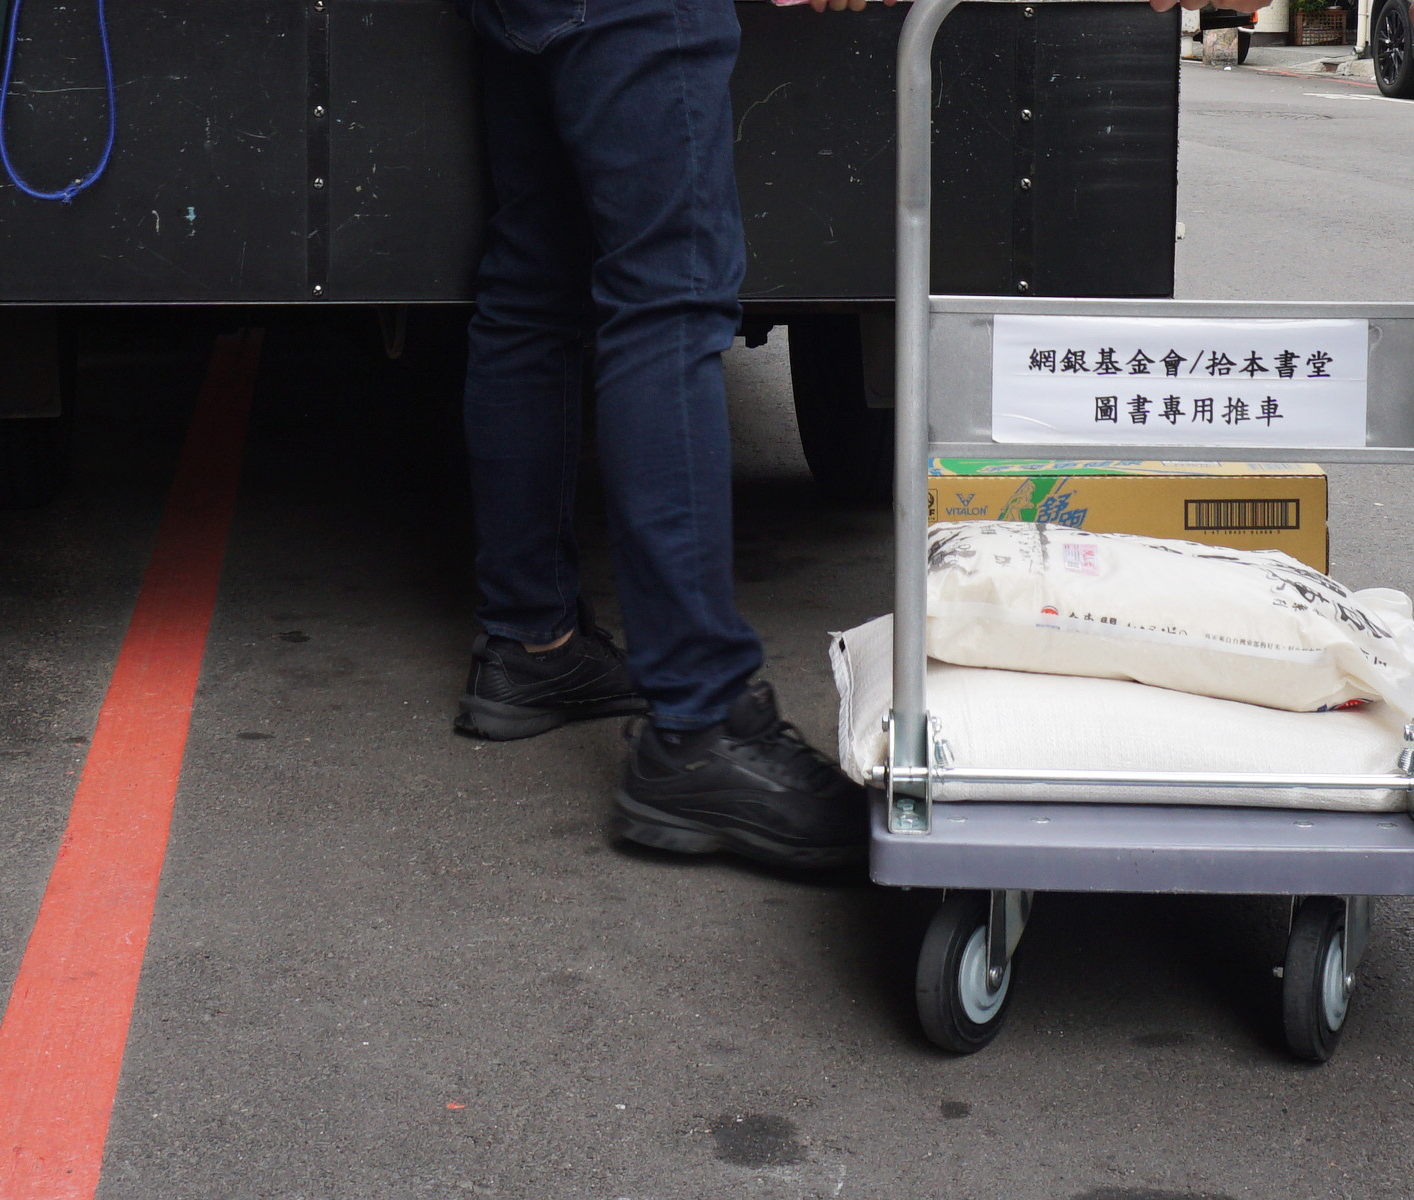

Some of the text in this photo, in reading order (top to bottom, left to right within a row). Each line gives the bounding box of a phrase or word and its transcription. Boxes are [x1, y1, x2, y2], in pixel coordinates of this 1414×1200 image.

[1027, 347, 1334, 379] 網銀基金會/拾本書堂
[1094, 394, 1284, 427] 圖書專用推車
[945, 507, 987, 516] VITALON
[1038, 492, 1088, 531] 舒跑
